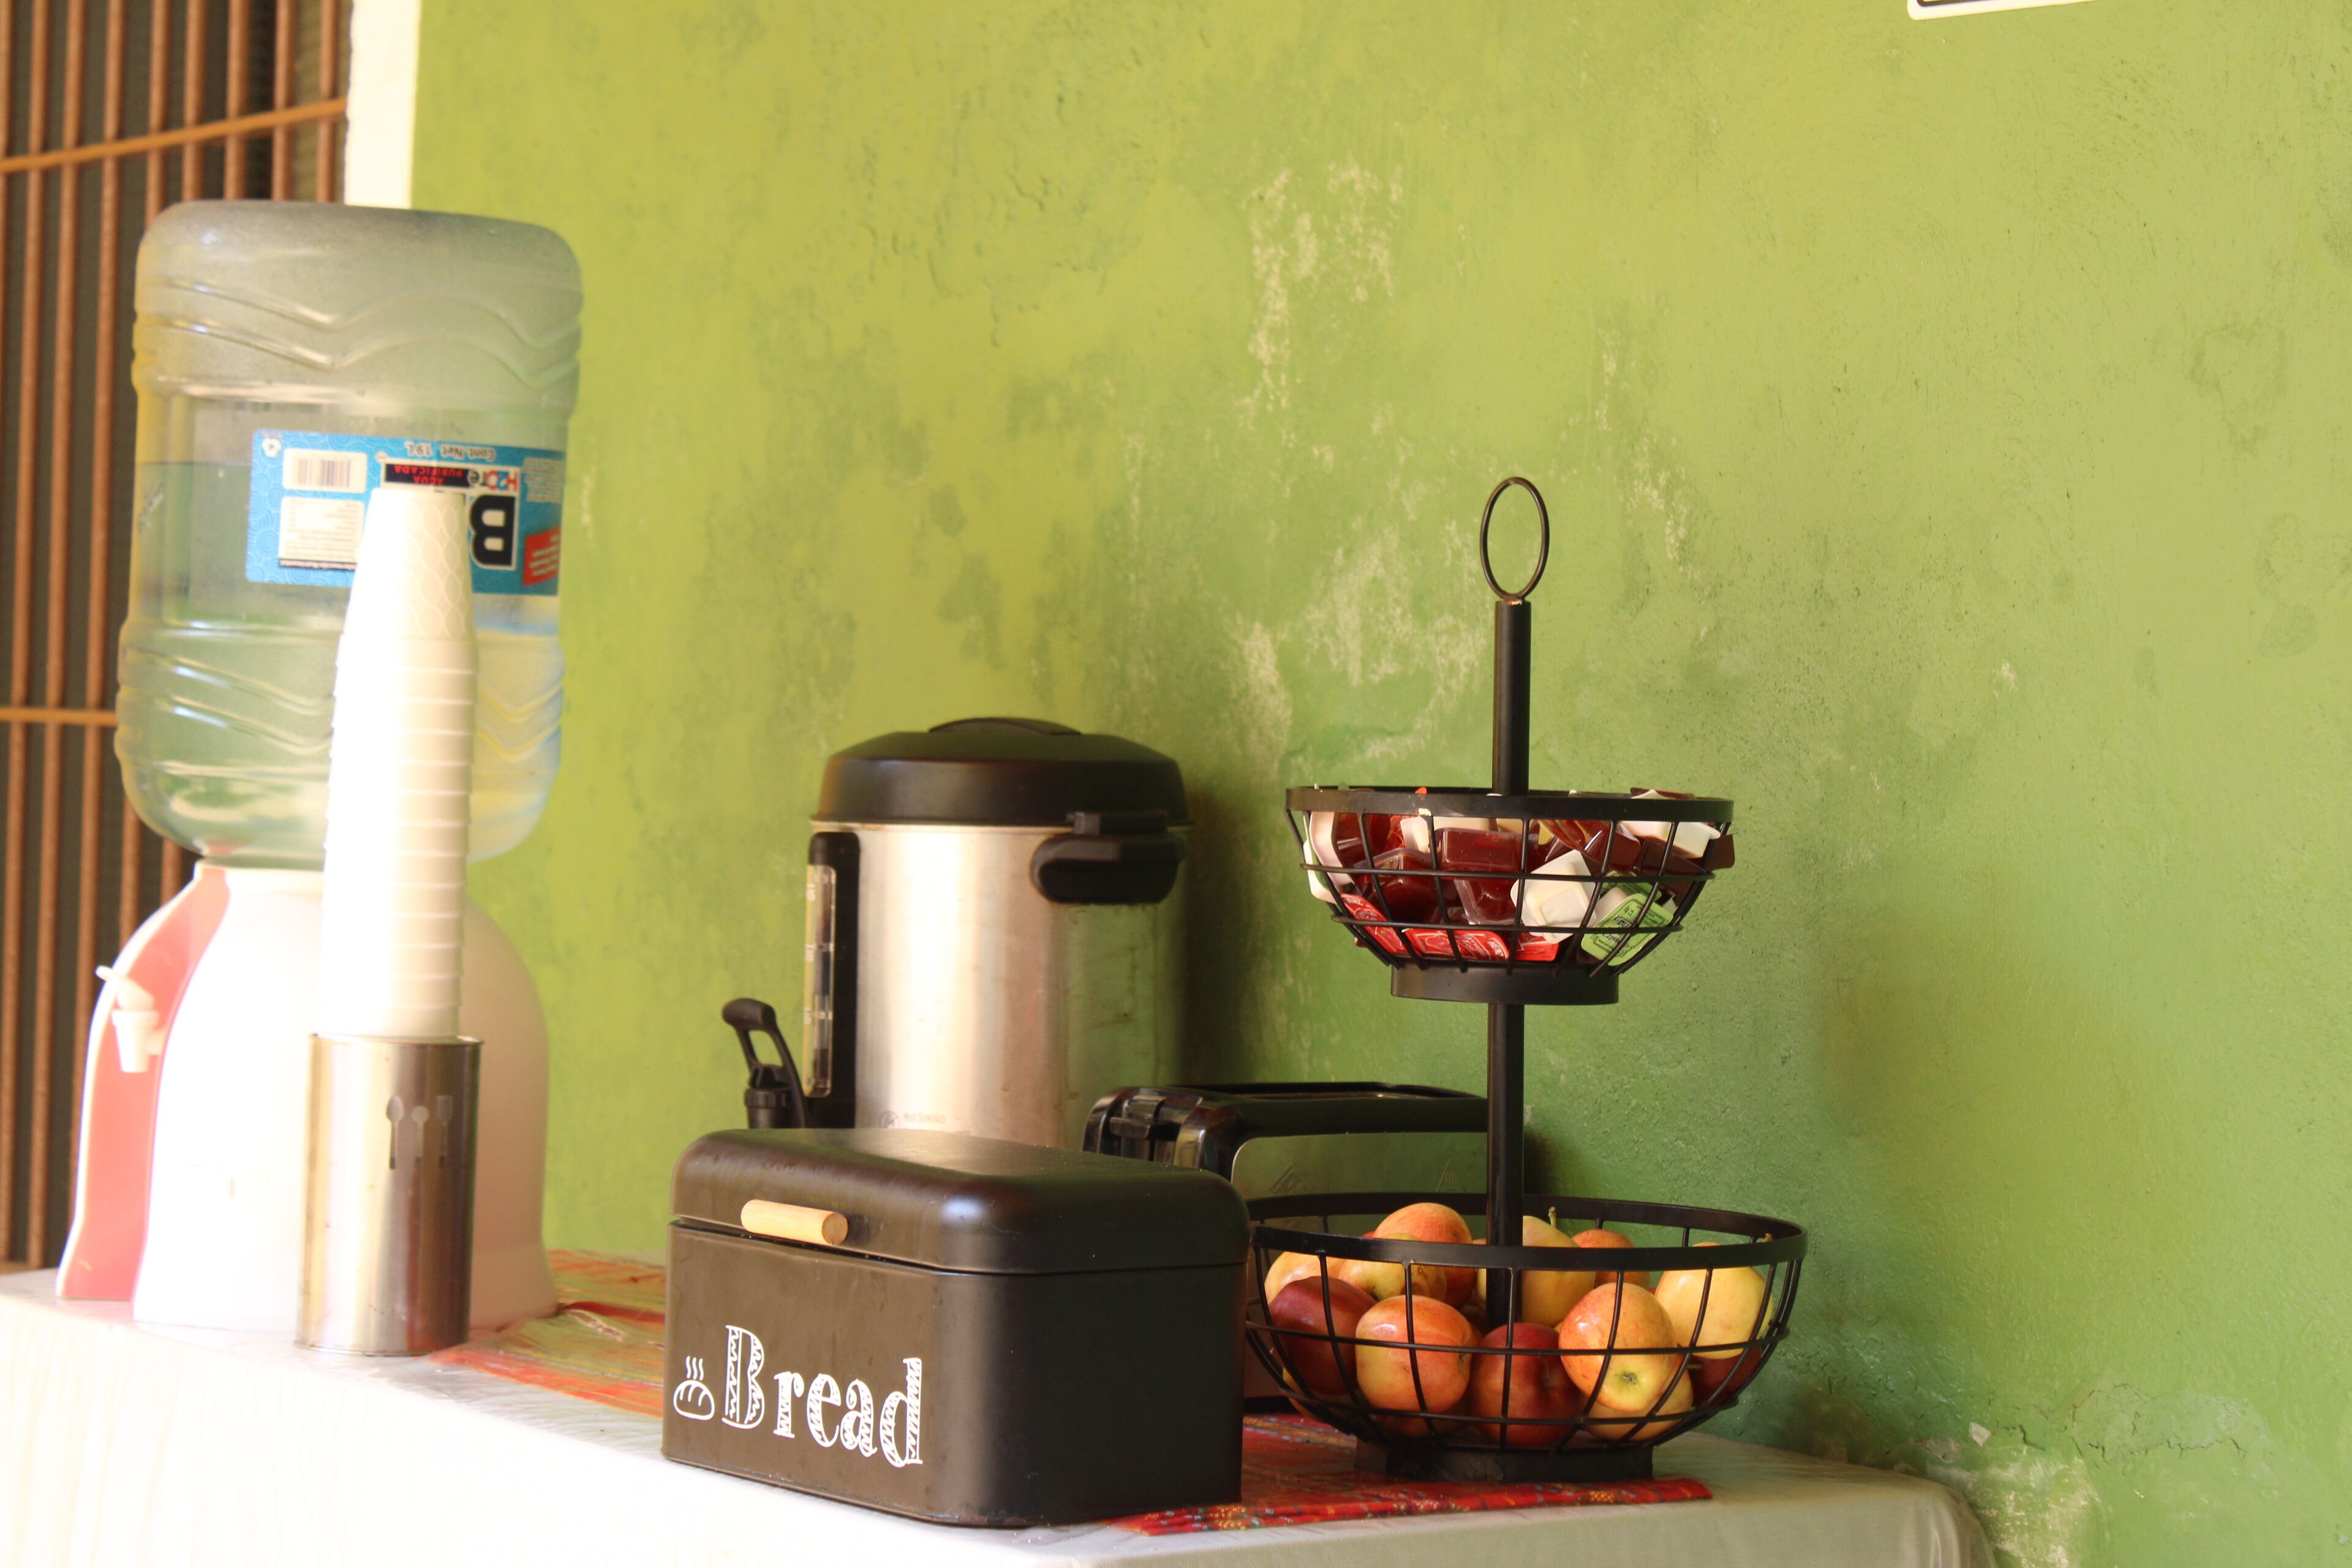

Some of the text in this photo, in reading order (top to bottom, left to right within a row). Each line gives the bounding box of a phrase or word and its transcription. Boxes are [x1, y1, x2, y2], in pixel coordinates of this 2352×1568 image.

[394, 464, 464, 478] PURIFICADA
[413, 476, 445, 485] AGUA
[722, 1325, 923, 1468] Bread
